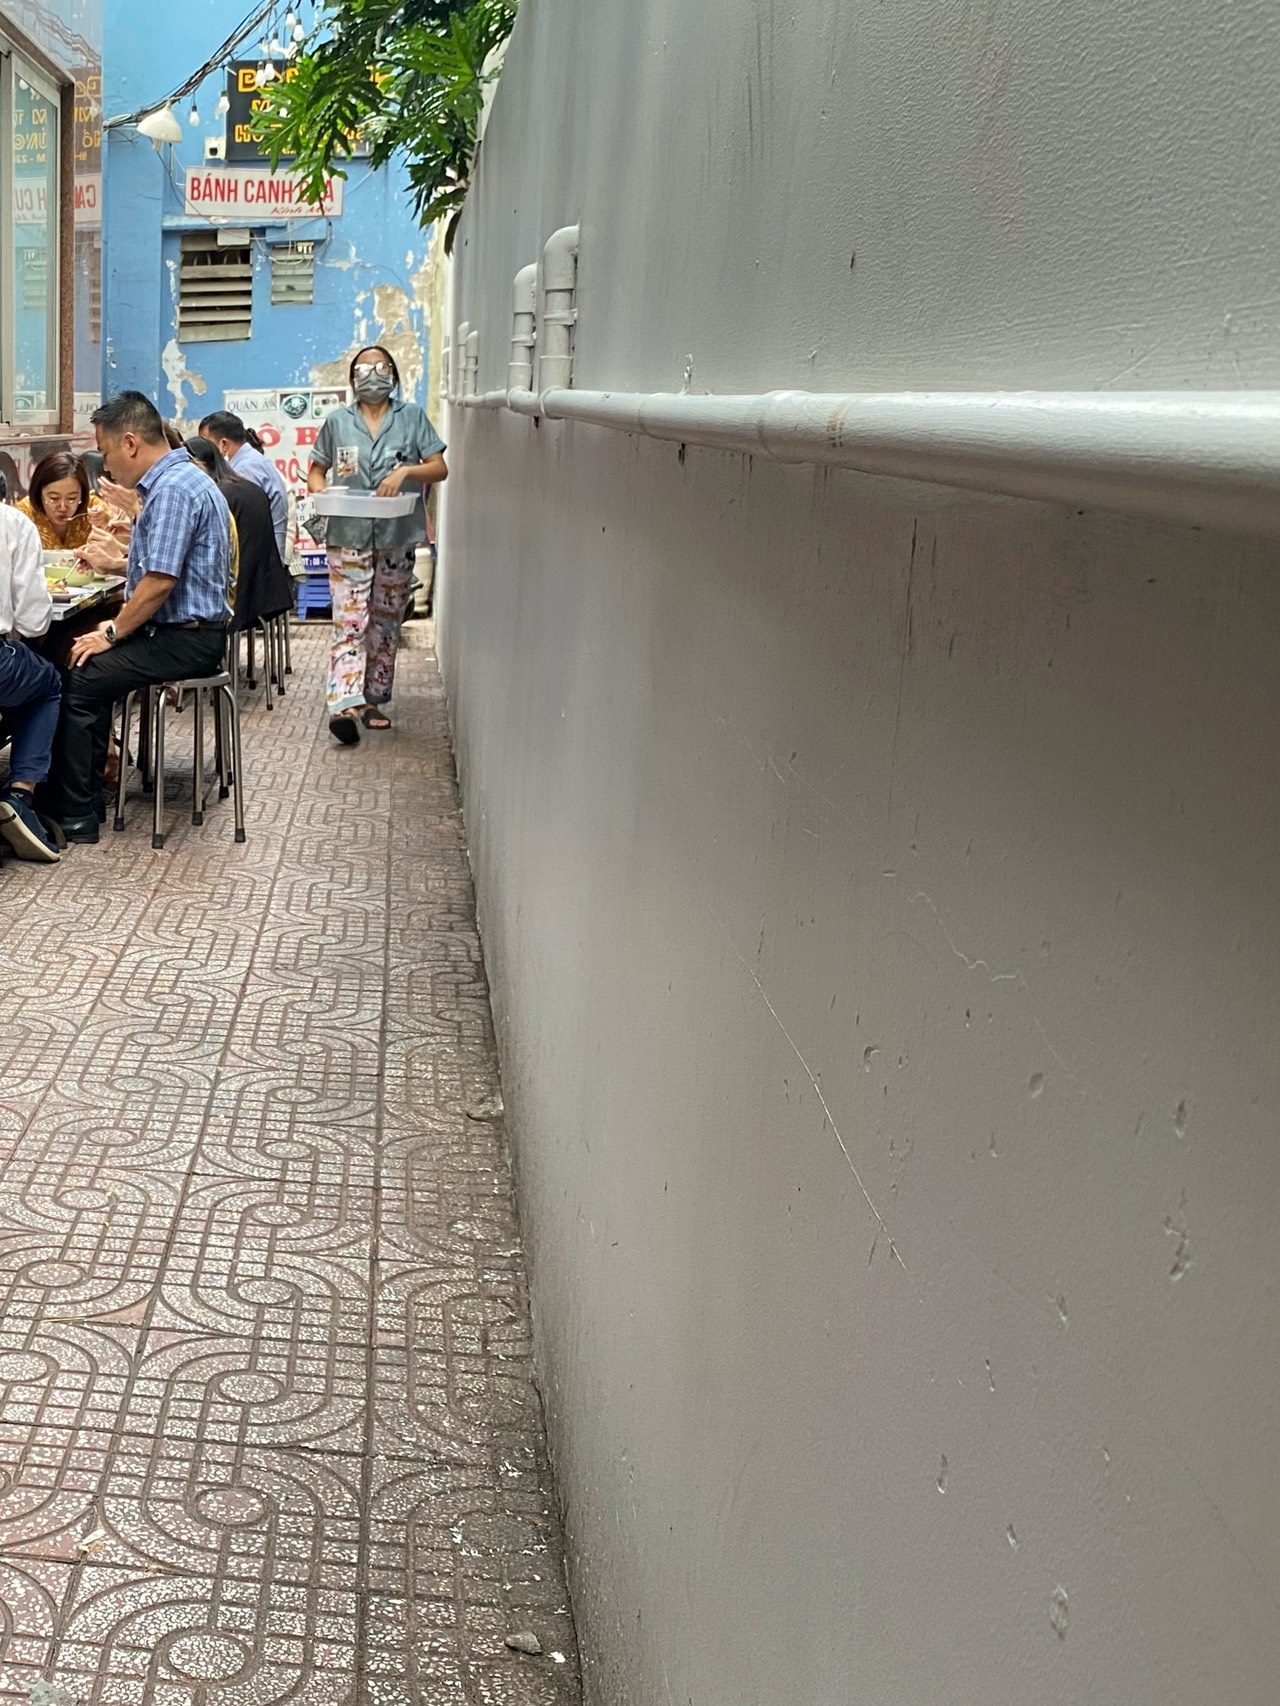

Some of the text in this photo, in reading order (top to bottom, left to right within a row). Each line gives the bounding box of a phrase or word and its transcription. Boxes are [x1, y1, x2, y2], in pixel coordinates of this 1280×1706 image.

[191, 173, 334, 203] BÁNH CANH CA
[227, 397, 258, 413] QUÁN
